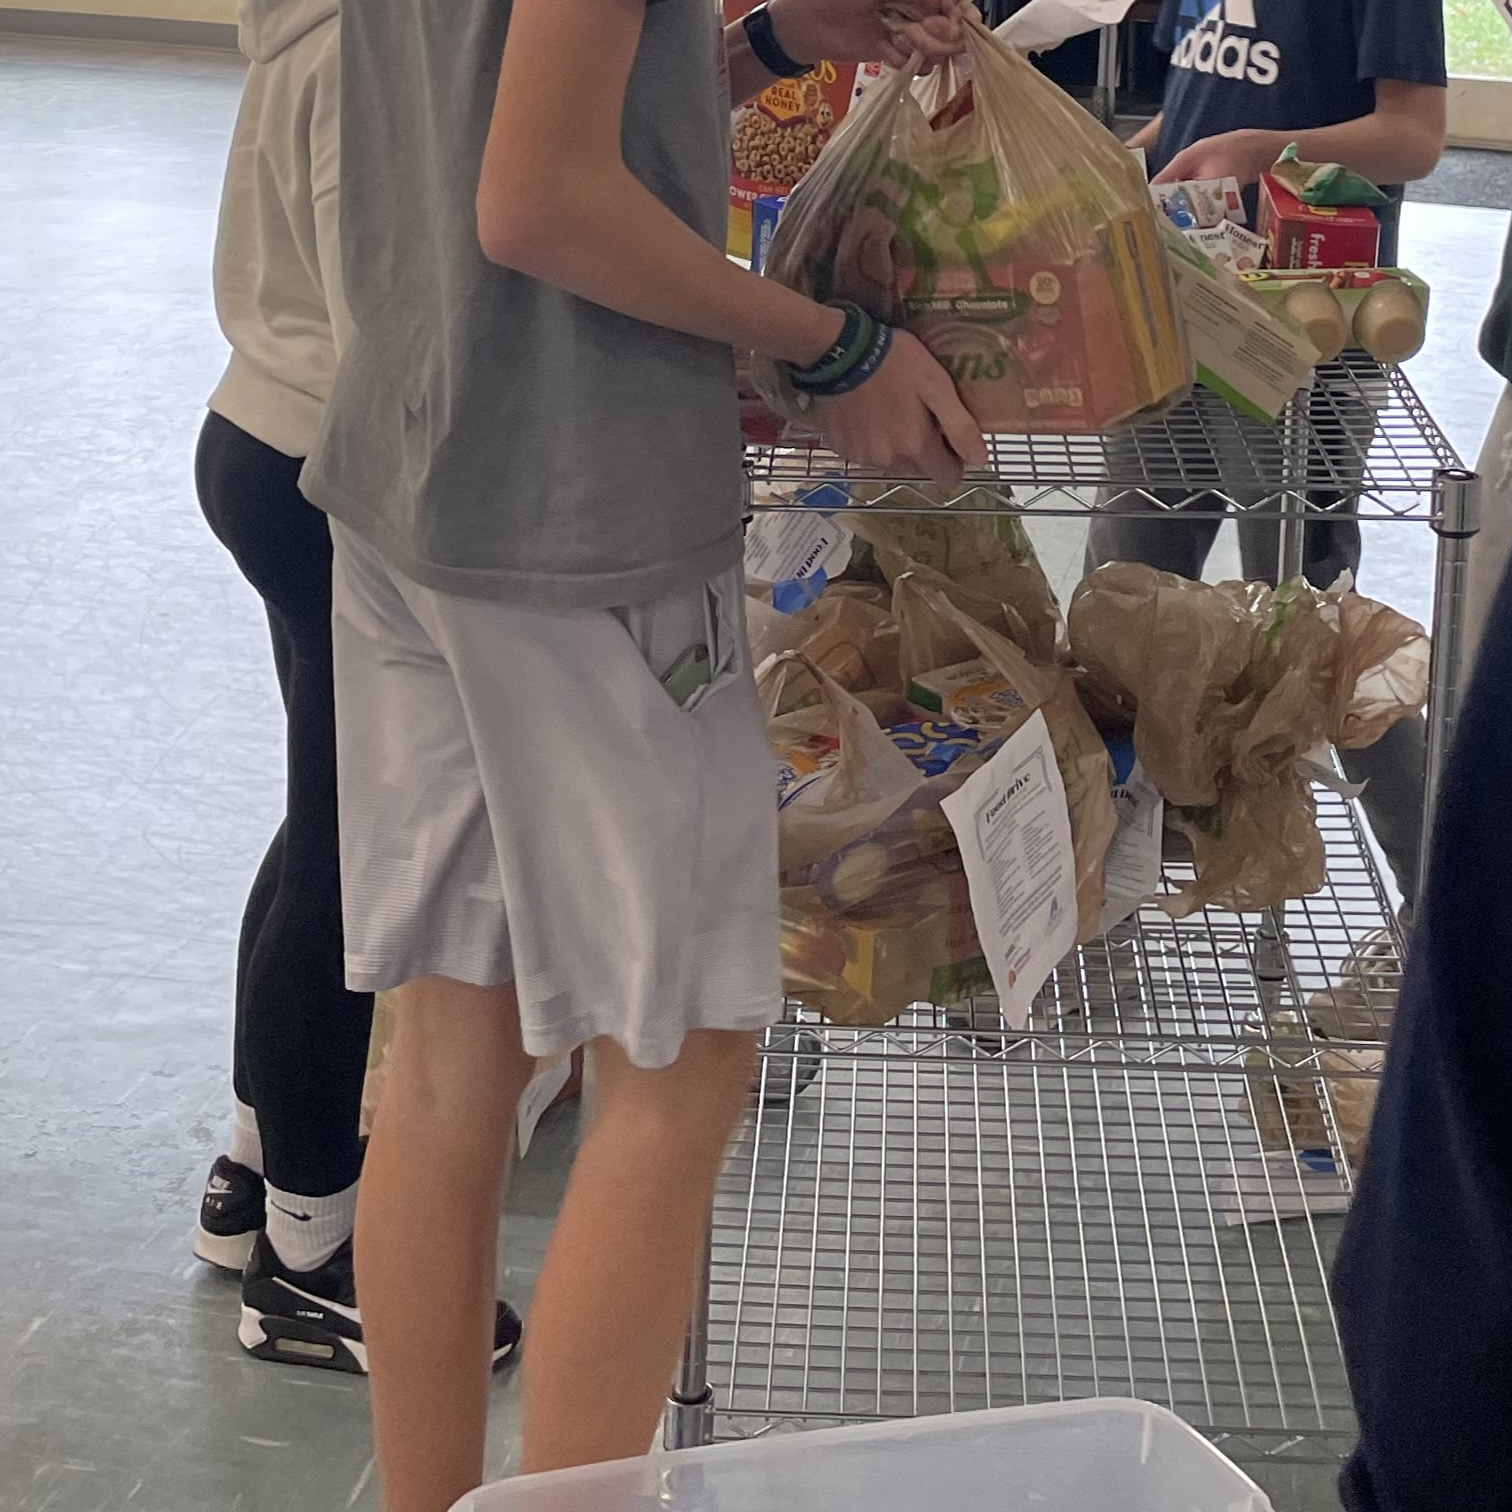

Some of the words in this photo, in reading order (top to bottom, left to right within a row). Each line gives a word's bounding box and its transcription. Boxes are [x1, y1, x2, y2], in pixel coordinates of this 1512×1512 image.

[771, 86, 797, 101] REAL
[765, 96, 801, 111] HONEY
[729, 185, 758, 201] OWER
[1225, 223, 1266, 249] Honest
[1307, 233, 1326, 269] fresh
